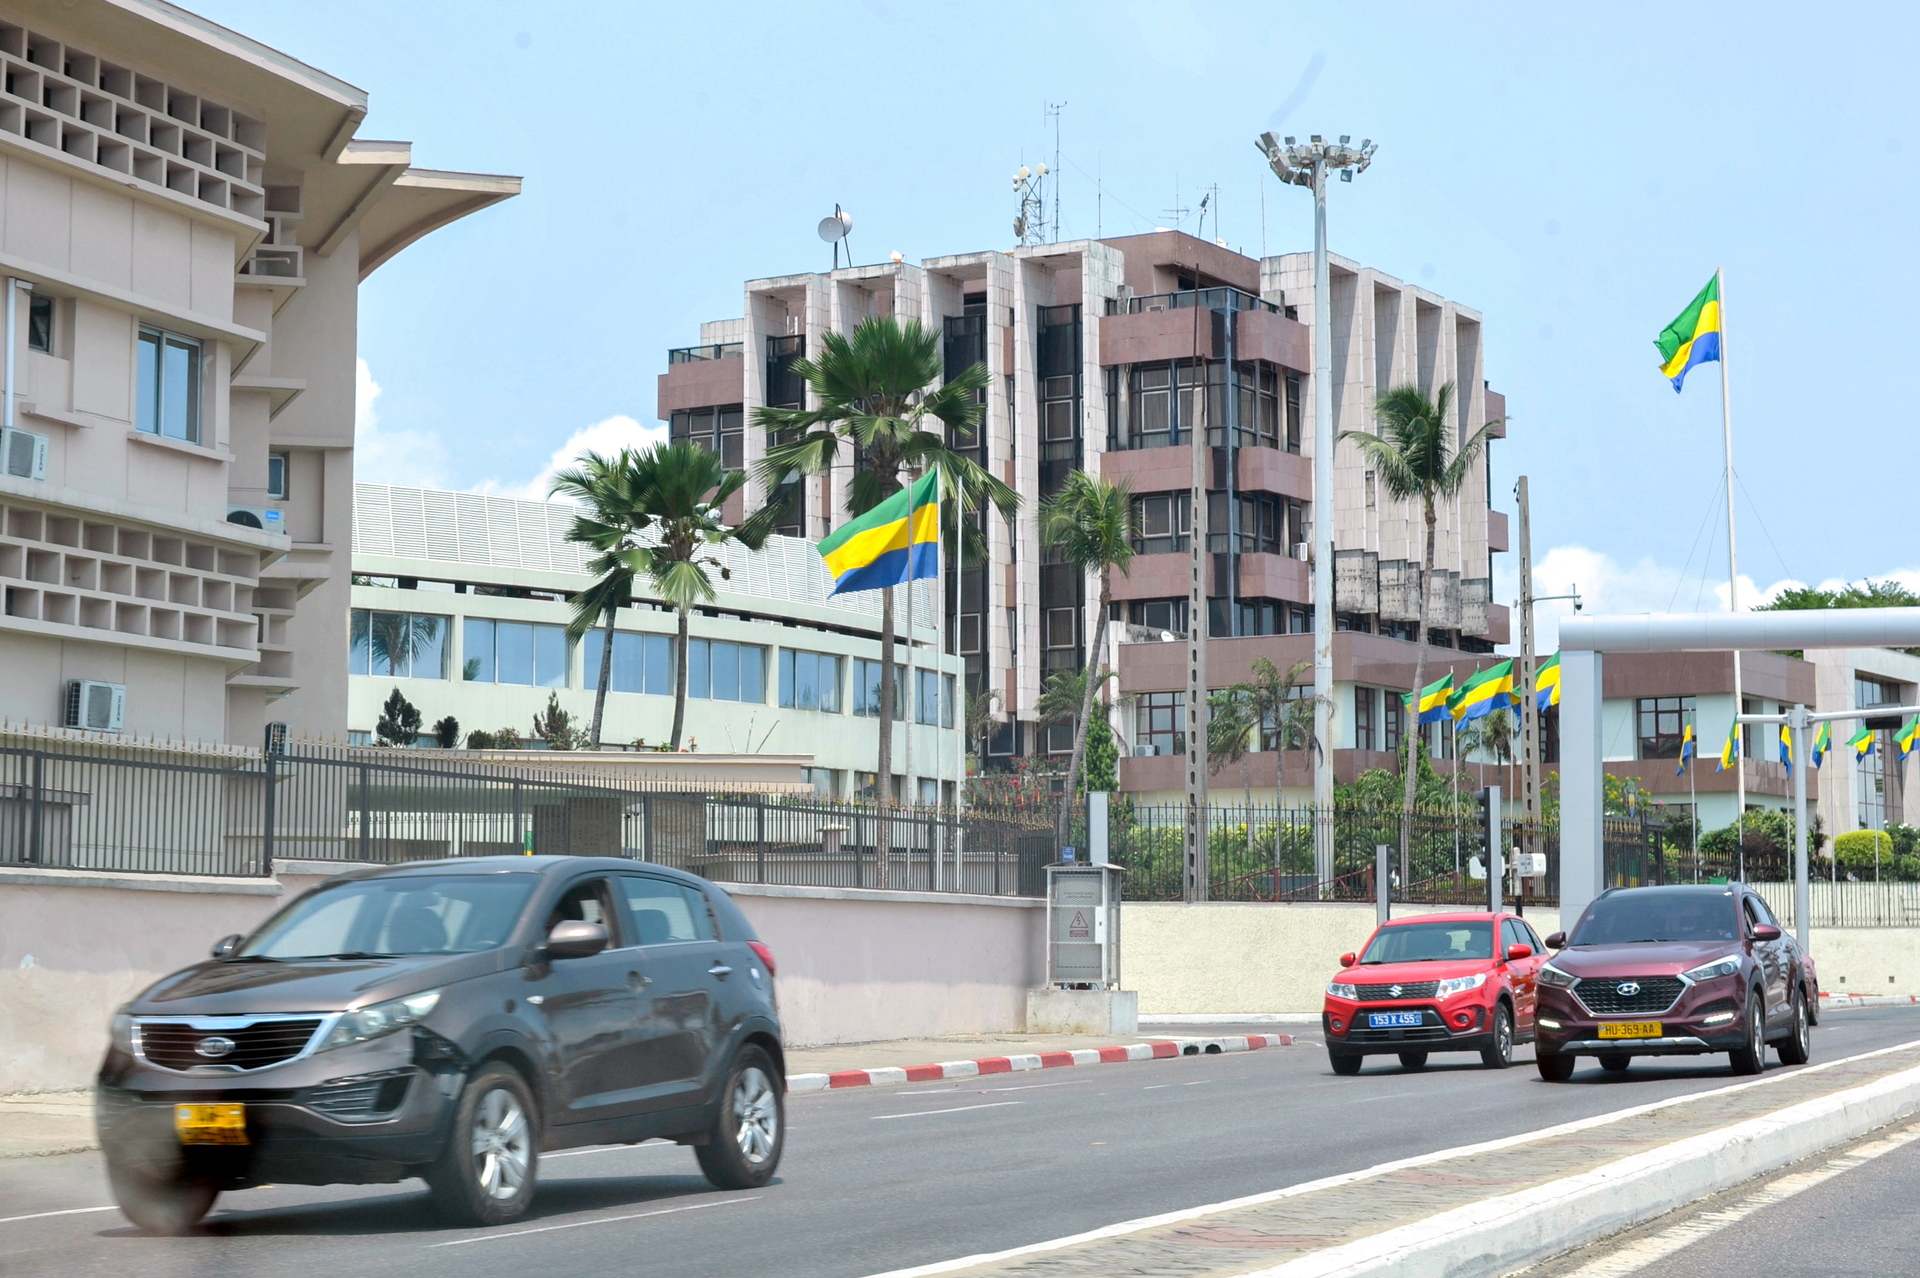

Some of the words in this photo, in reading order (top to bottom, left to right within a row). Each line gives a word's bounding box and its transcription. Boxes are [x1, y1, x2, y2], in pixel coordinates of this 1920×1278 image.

[1374, 1015, 1389, 1025] 153
[1390, 1015, 1397, 1024] X
[1399, 1014, 1415, 1024] 455
[1605, 1024, 1655, 1035] HU-369-AA
